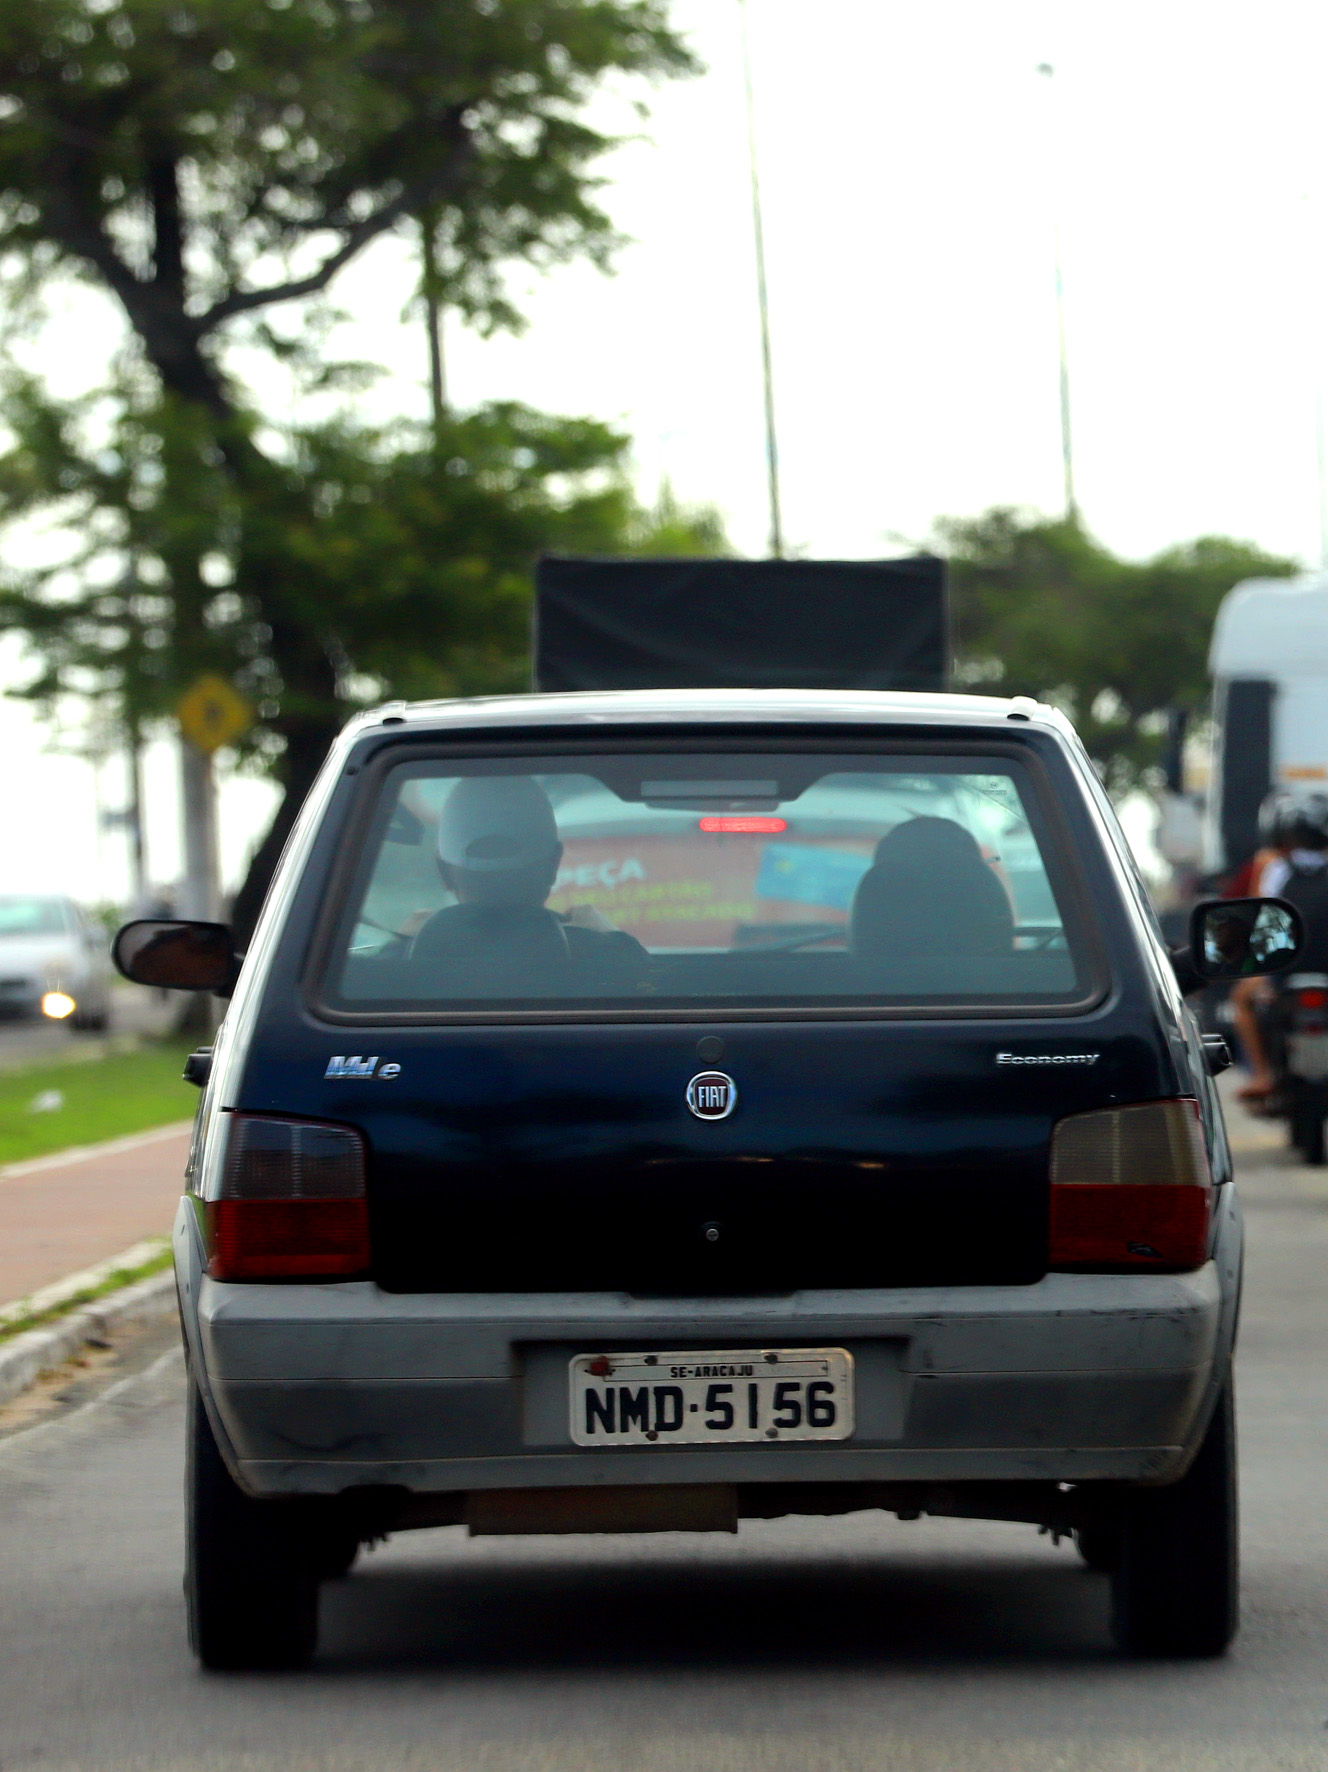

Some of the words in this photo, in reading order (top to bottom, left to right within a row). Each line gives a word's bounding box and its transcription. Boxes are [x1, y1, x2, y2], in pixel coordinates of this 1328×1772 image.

[996, 1053, 1100, 1066] Economy
[698, 1086, 727, 1108] FIAT
[670, 1365, 753, 1378] SE-ARACAJU
